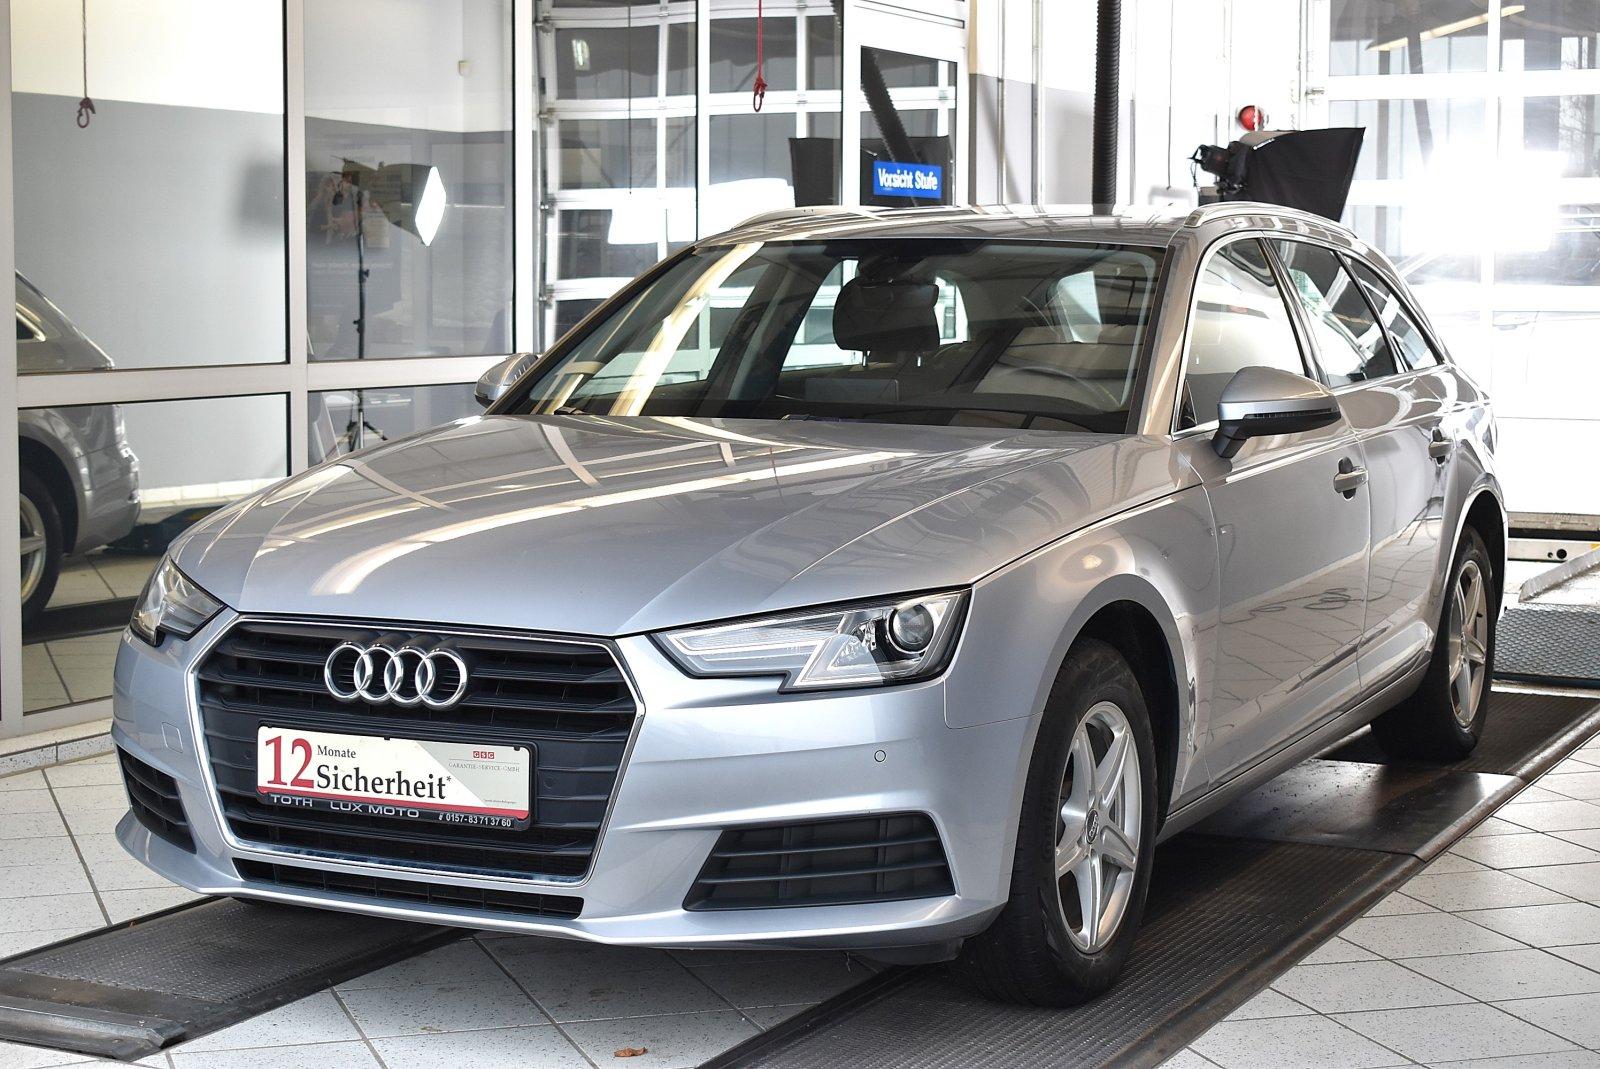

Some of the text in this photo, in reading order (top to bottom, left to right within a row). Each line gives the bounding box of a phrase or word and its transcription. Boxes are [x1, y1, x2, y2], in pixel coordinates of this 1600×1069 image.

[878, 168, 938, 190] Vorsicht Stufe
[265, 735, 314, 788] 12
[317, 745, 357, 759] Monate
[270, 794, 419, 818] TOTH LUX MOTO
[501, 818, 511, 827] 60
